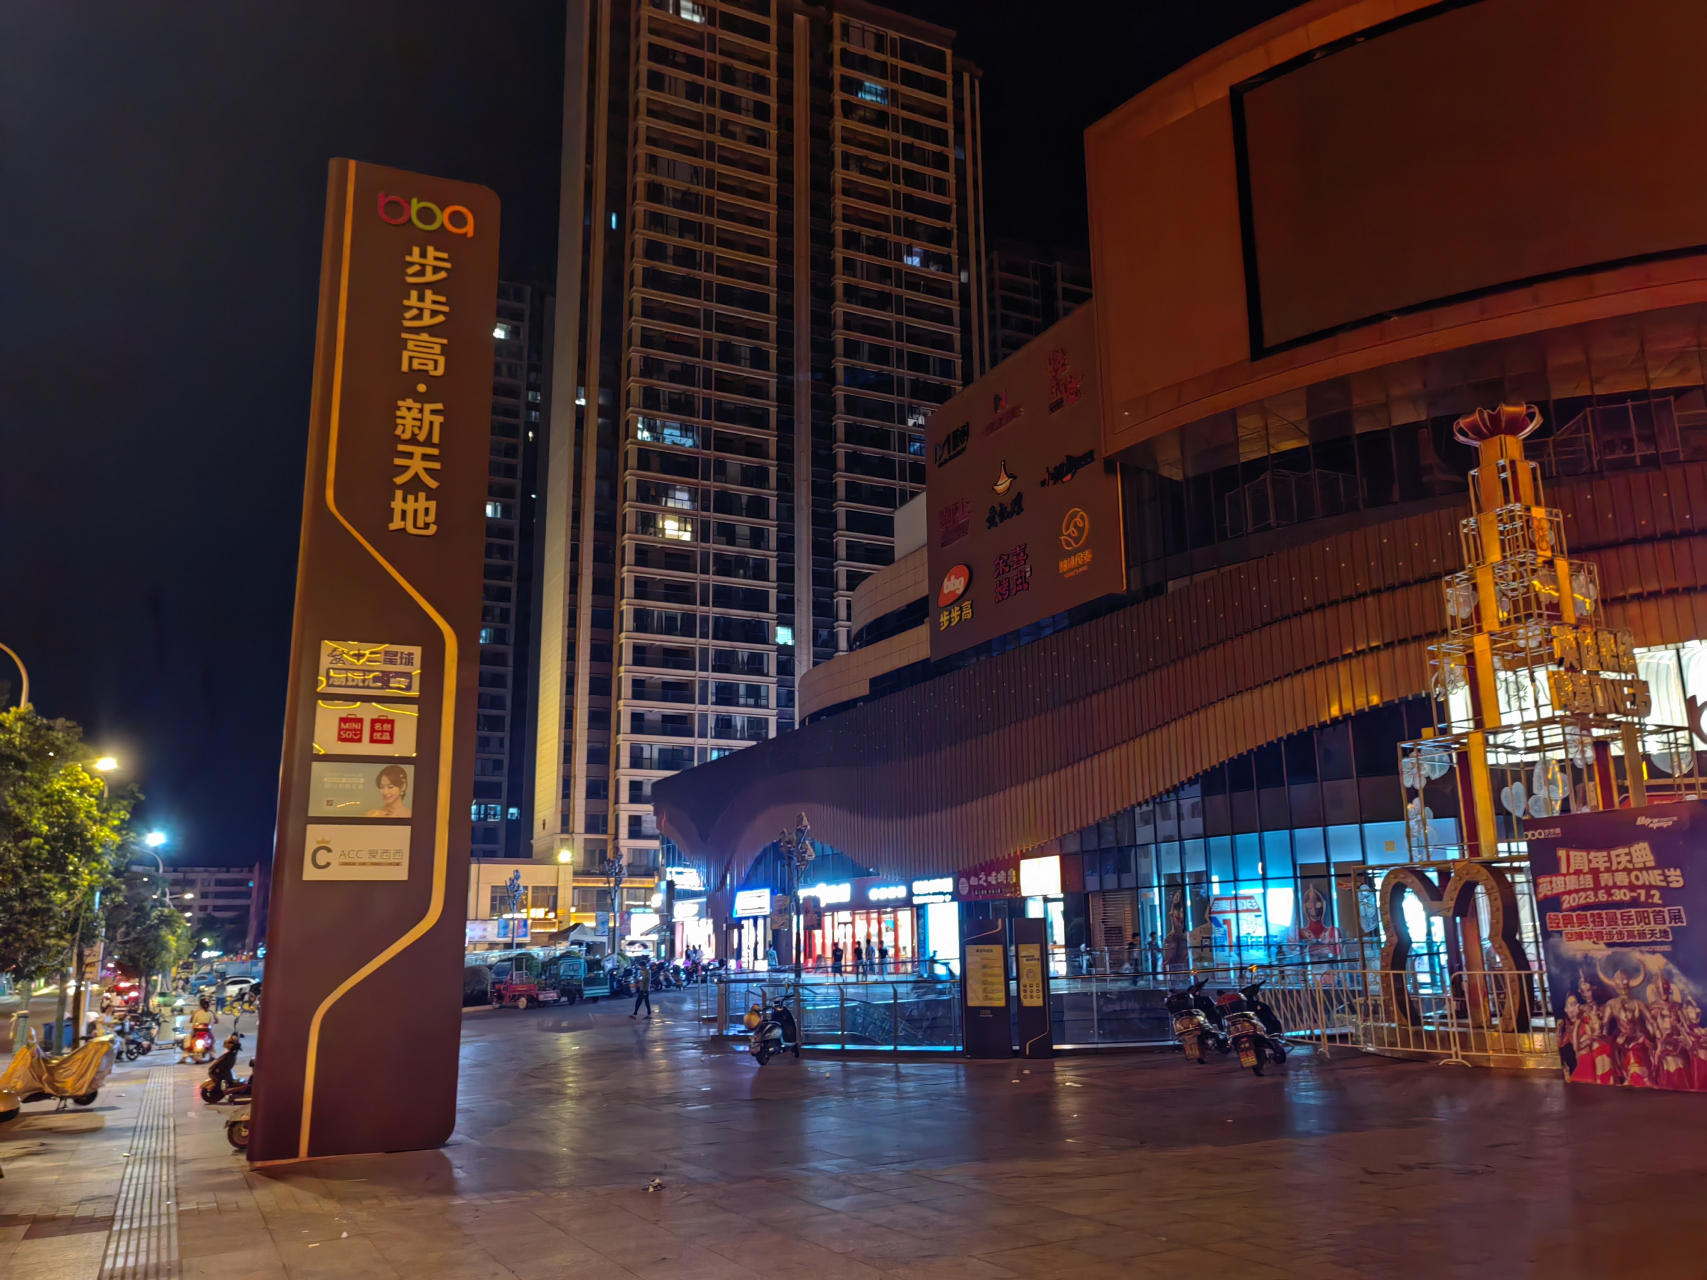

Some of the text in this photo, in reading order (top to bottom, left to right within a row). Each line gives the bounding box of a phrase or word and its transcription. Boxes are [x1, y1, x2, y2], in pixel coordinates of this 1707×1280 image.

[940, 600, 973, 631] 步步高
[340, 721, 361, 729] MINI
[338, 848, 404, 860] ACC 爱西西
[1557, 842, 1656, 874] 1周年庆典
[1538, 874, 1594, 897] 英雄集结
[1562, 889, 1663, 909] 2023.6.30-7.2
[1547, 907, 1685, 930] 经典奥特曼岳阳首展
